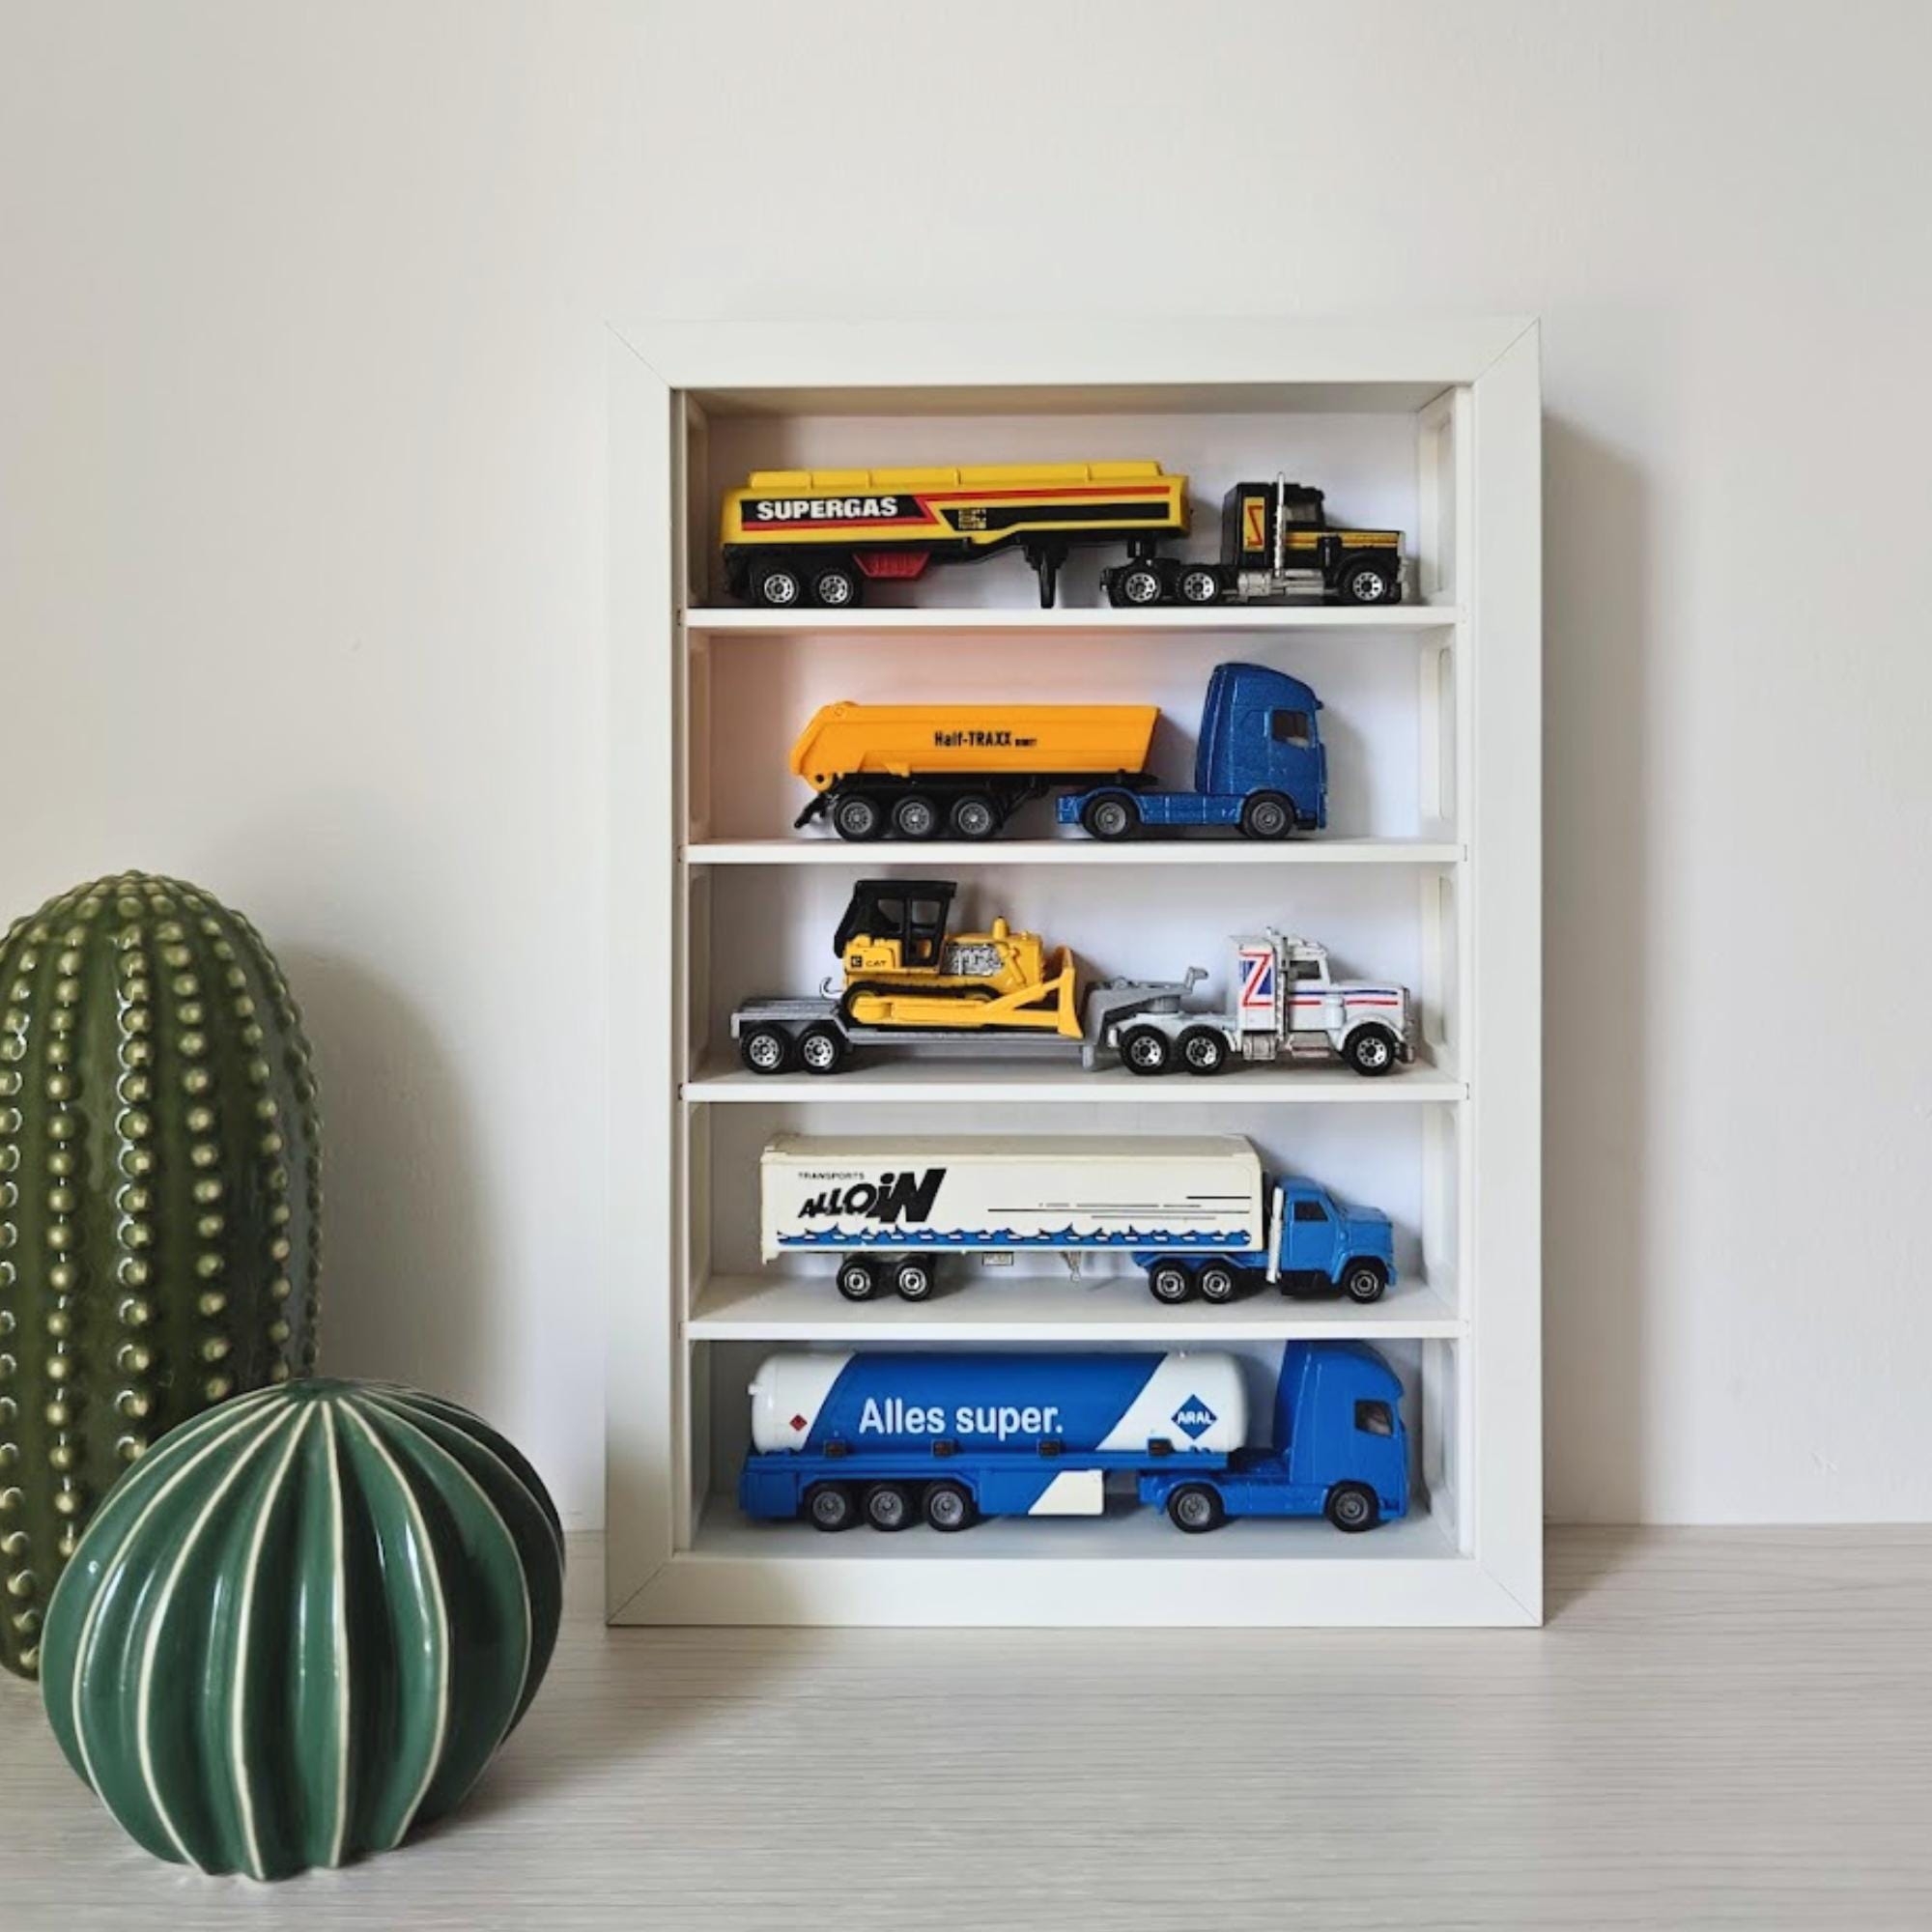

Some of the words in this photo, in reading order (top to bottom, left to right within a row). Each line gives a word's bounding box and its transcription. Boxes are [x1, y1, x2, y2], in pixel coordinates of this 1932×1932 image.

[756, 497, 898, 521] SUPERGAS
[934, 729, 1012, 748] Half-TRAXX
[798, 1172, 865, 1180] TRANSPORTS
[859, 1398, 946, 1434] Alles
[955, 1405, 1063, 1441] super.
[1177, 1410, 1213, 1425] ARAL
